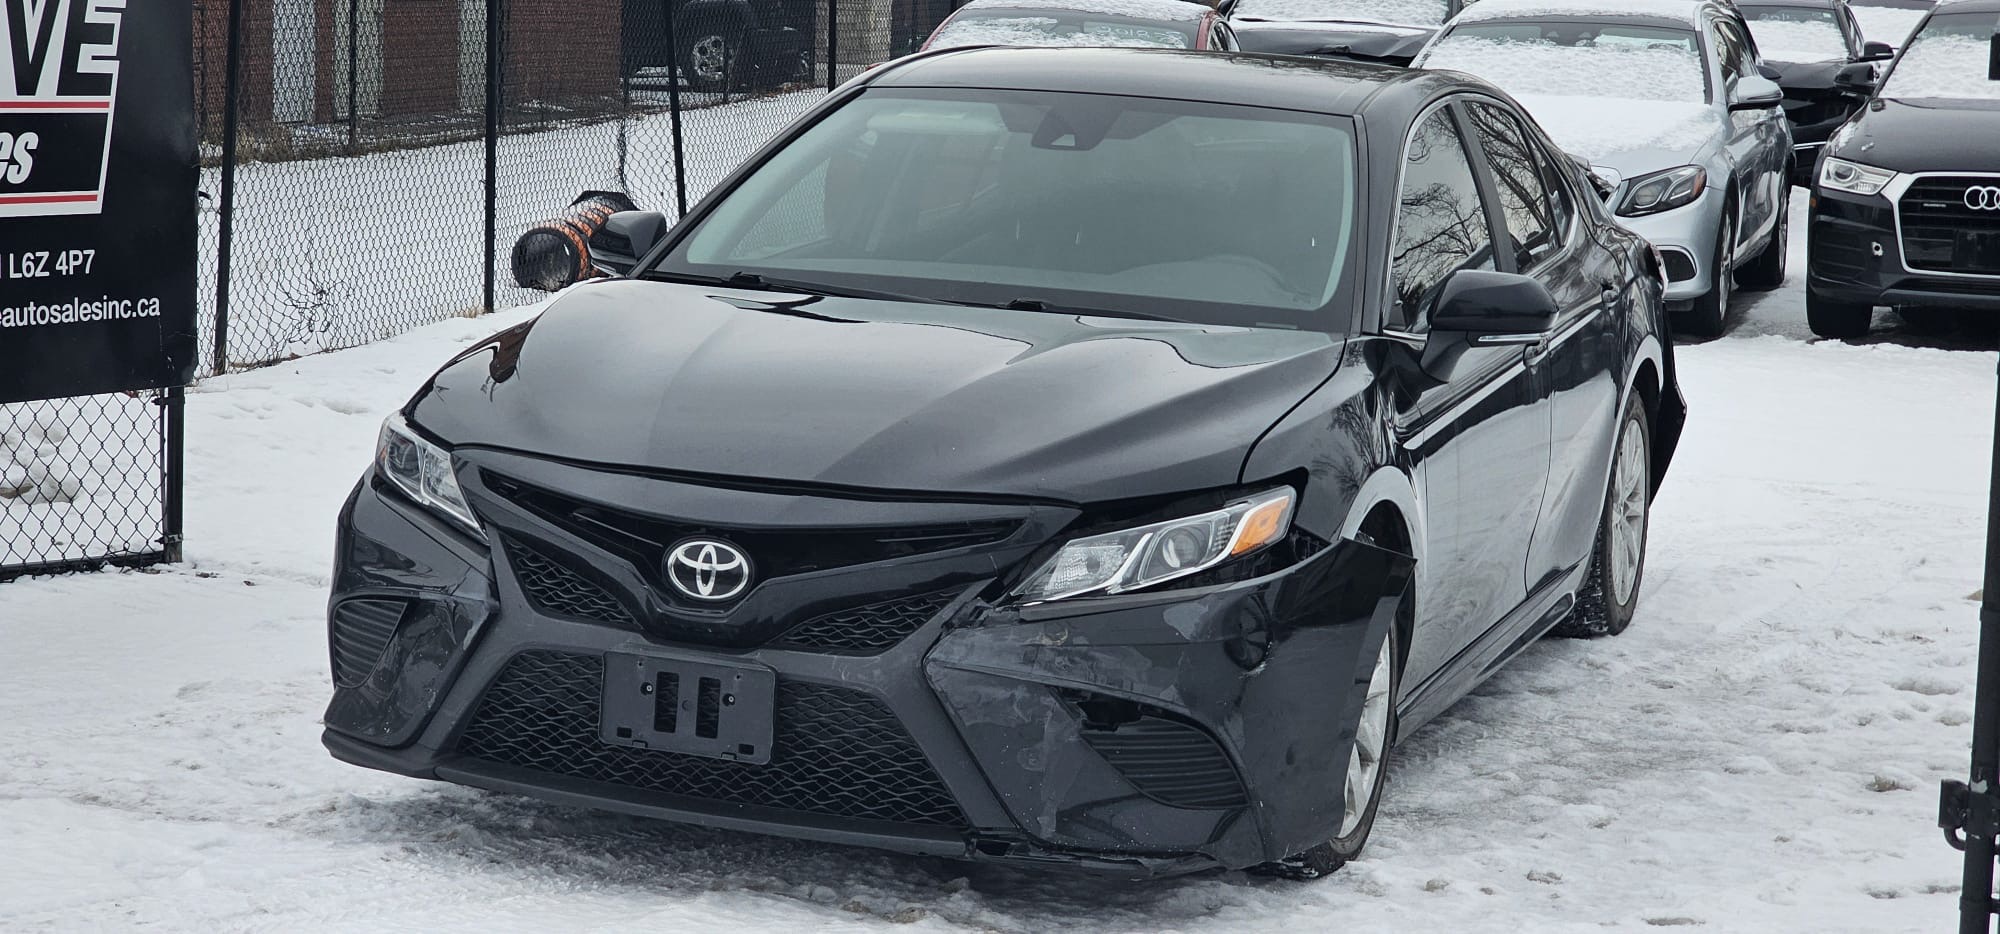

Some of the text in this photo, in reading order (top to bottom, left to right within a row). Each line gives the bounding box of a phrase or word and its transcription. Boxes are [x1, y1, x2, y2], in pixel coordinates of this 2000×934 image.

[9, 251, 50, 279] L6Z
[55, 249, 96, 276] 4P7
[0, 295, 161, 328] autosalesinc.ca
